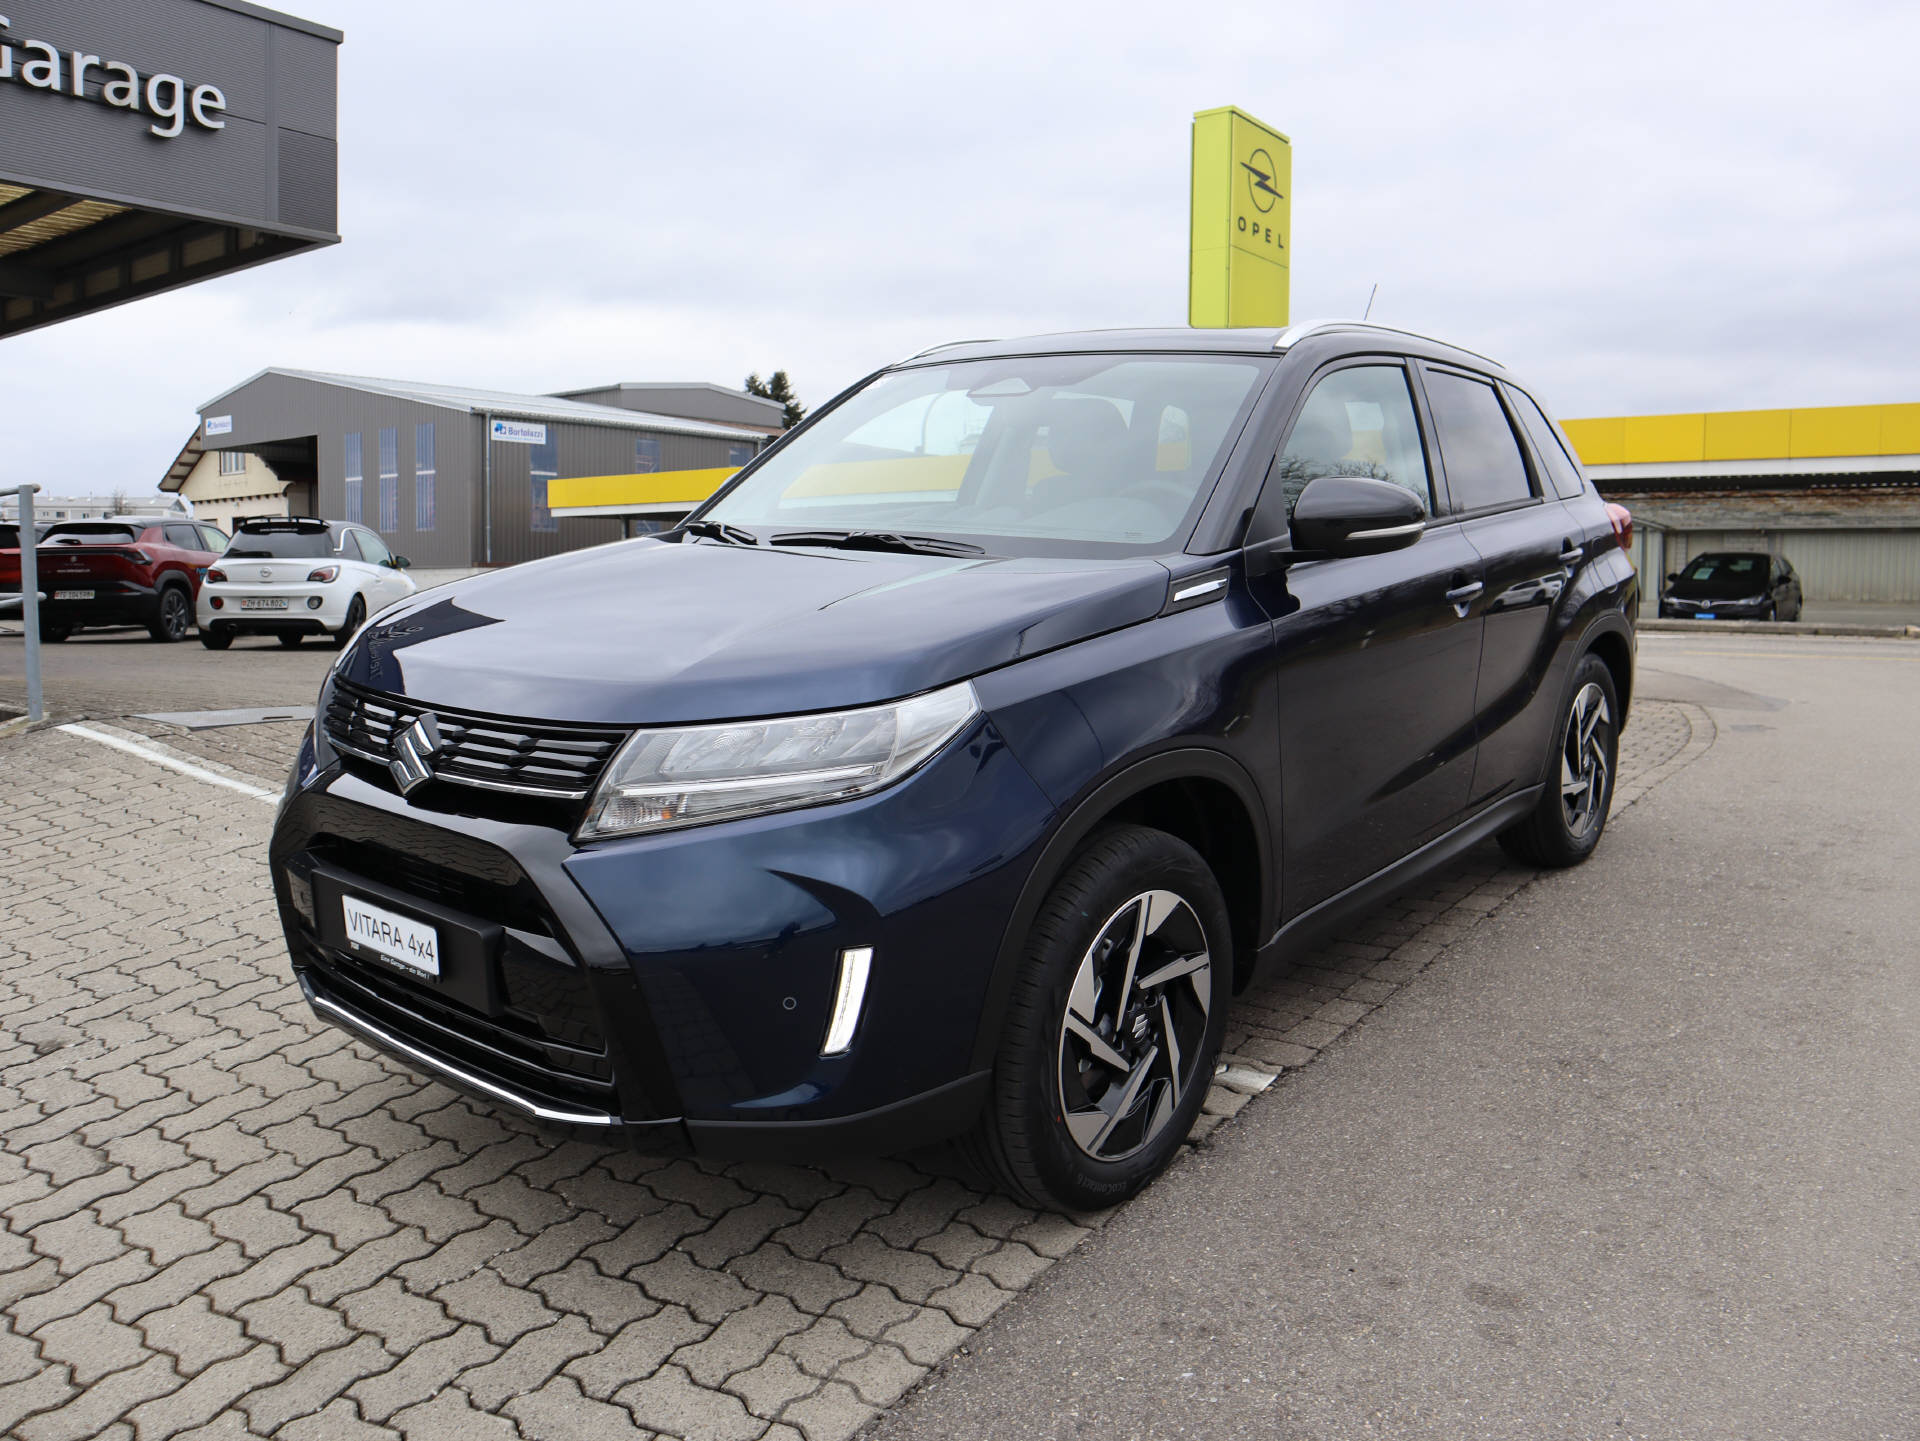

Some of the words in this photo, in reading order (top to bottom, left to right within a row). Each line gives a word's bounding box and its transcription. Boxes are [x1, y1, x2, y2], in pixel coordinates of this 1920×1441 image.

[1237, 216, 1284, 249] OPEL
[348, 908, 404, 951] VITARA
[408, 933, 435, 963] 4x4
